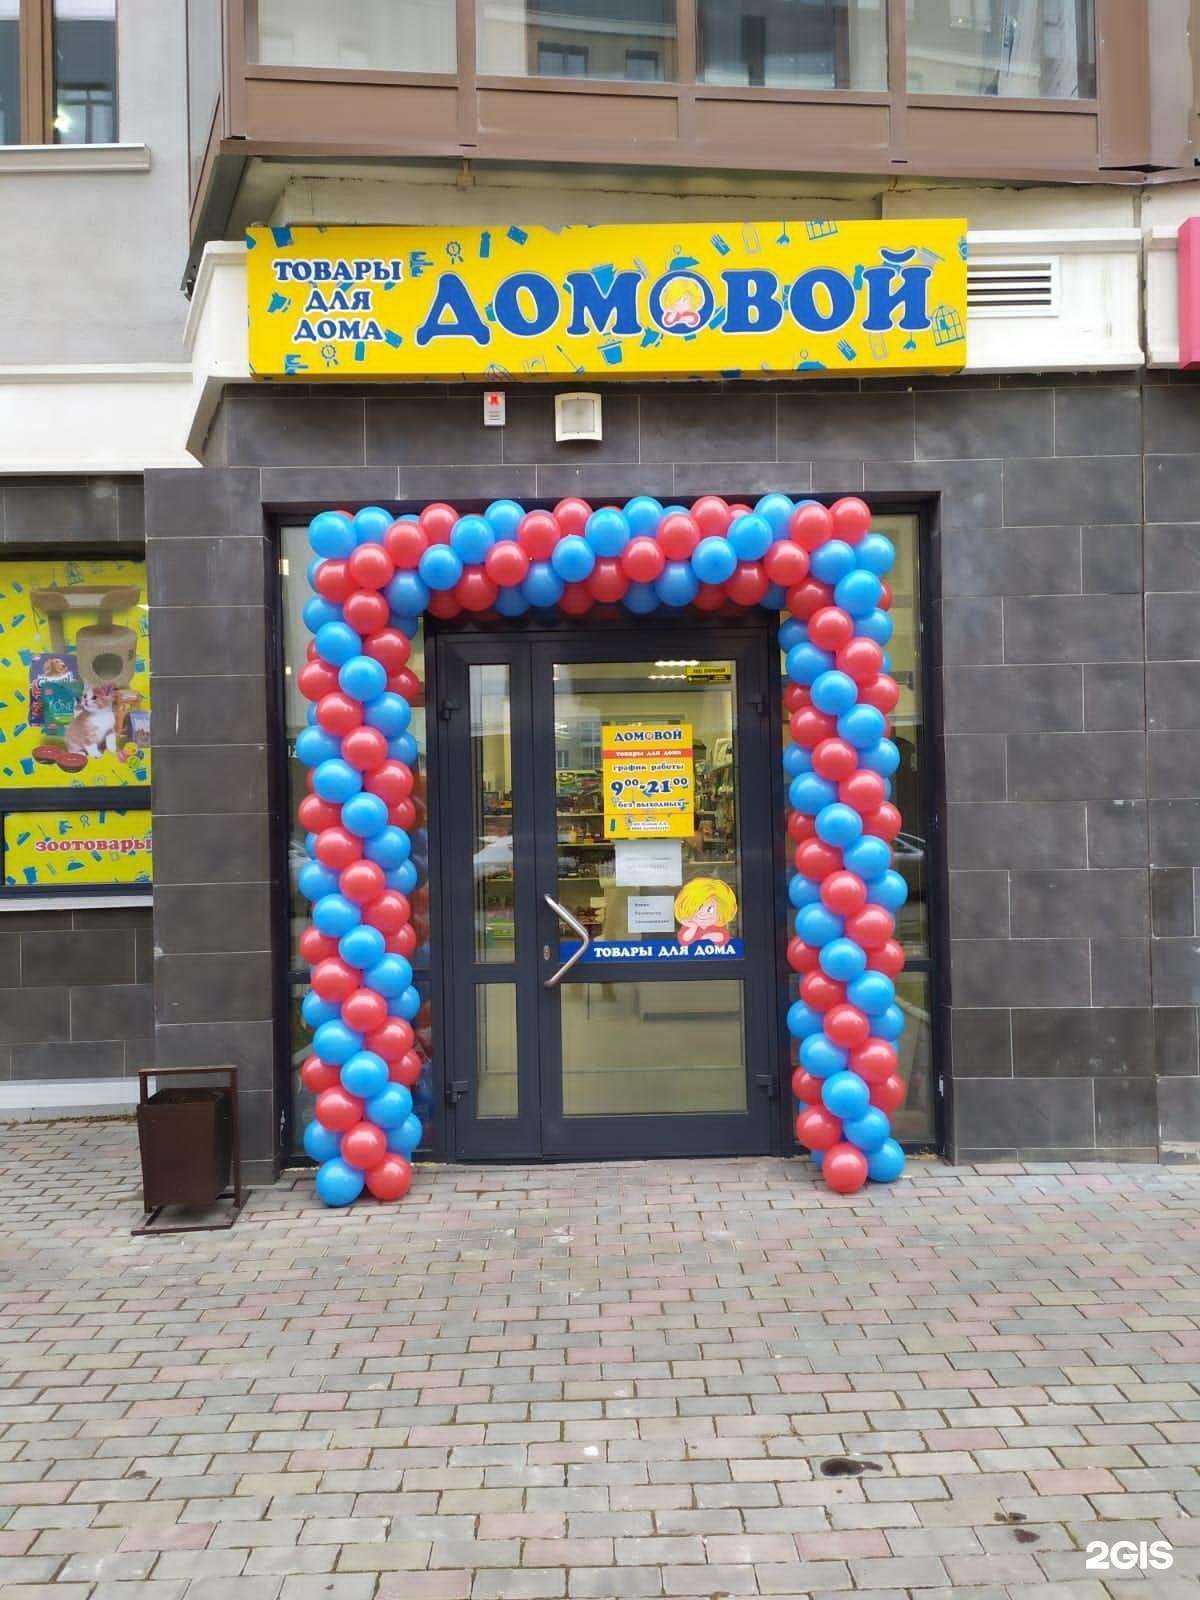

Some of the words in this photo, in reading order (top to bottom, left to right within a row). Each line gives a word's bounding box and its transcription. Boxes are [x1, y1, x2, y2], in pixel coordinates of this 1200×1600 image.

[274, 261, 401, 281] ТОВАРЫ
[305, 290, 371, 312] ДЛЯ
[416, 248, 932, 346] ДОМОВОЙ
[294, 319, 384, 341] ДОМА
[615, 729, 682, 741] ДОМОВОЙ
[613, 764, 646, 772] график
[651, 762, 684, 771] работы
[594, 947, 652, 958] ТОВАРЫ
[658, 946, 689, 957] ДЛЯ
[694, 945, 736, 956] ДОМА
